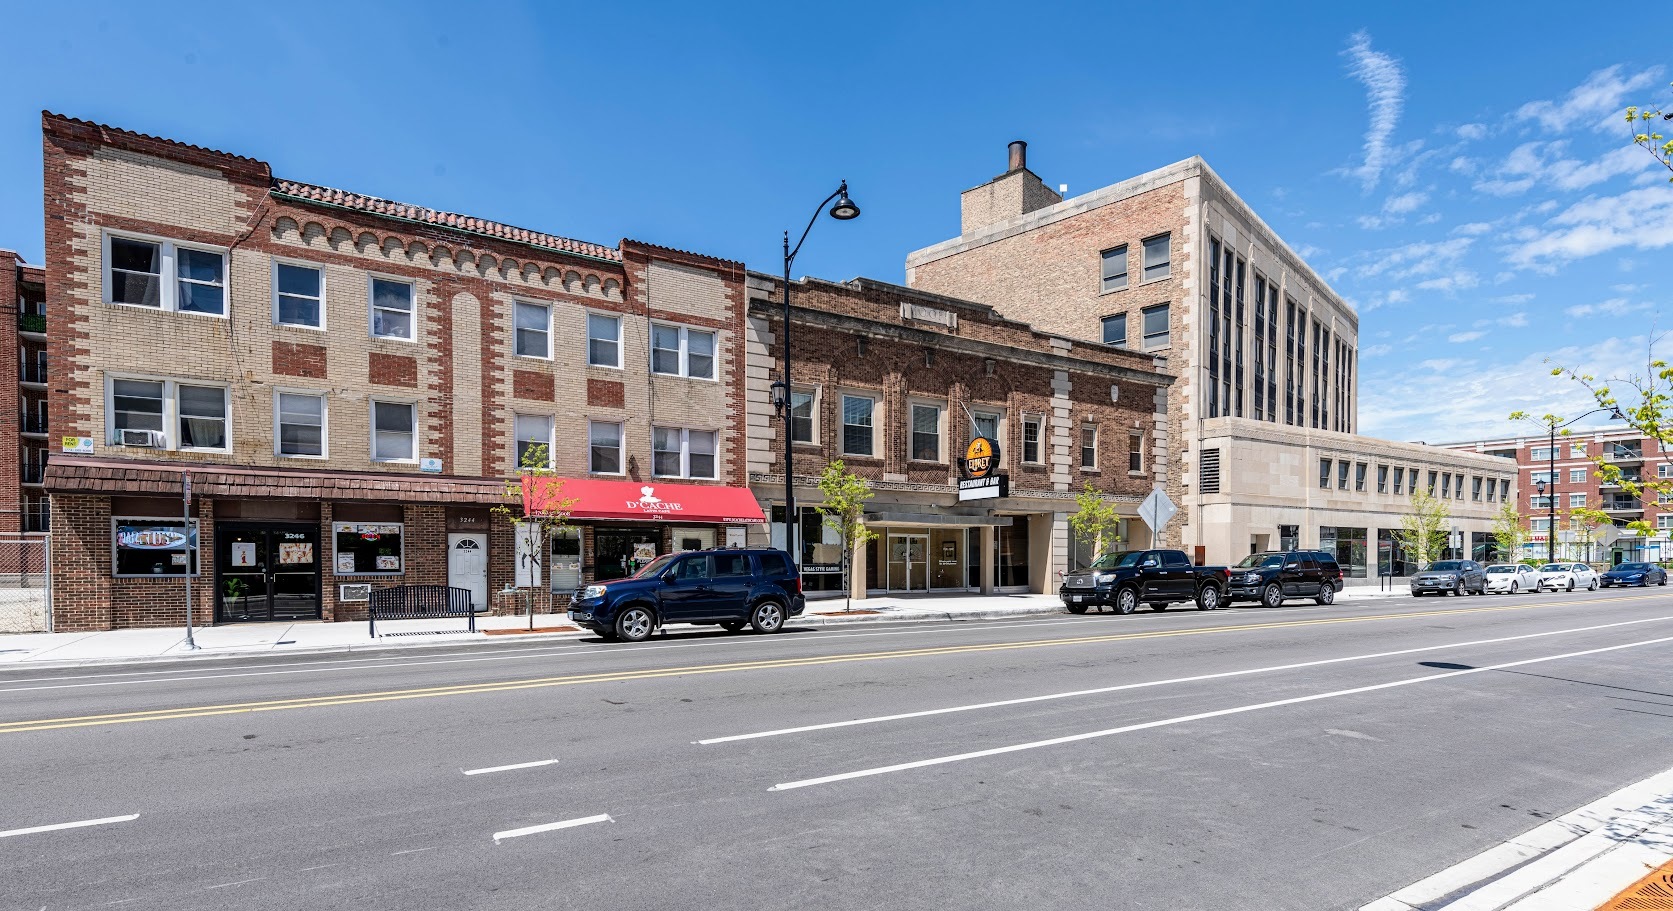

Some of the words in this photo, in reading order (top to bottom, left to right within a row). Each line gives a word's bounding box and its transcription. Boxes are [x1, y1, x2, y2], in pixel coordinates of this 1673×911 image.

[959, 478, 986, 489] RESTAURANT
[989, 476, 1000, 486] BAR
[625, 500, 683, 511] D'CACHE
